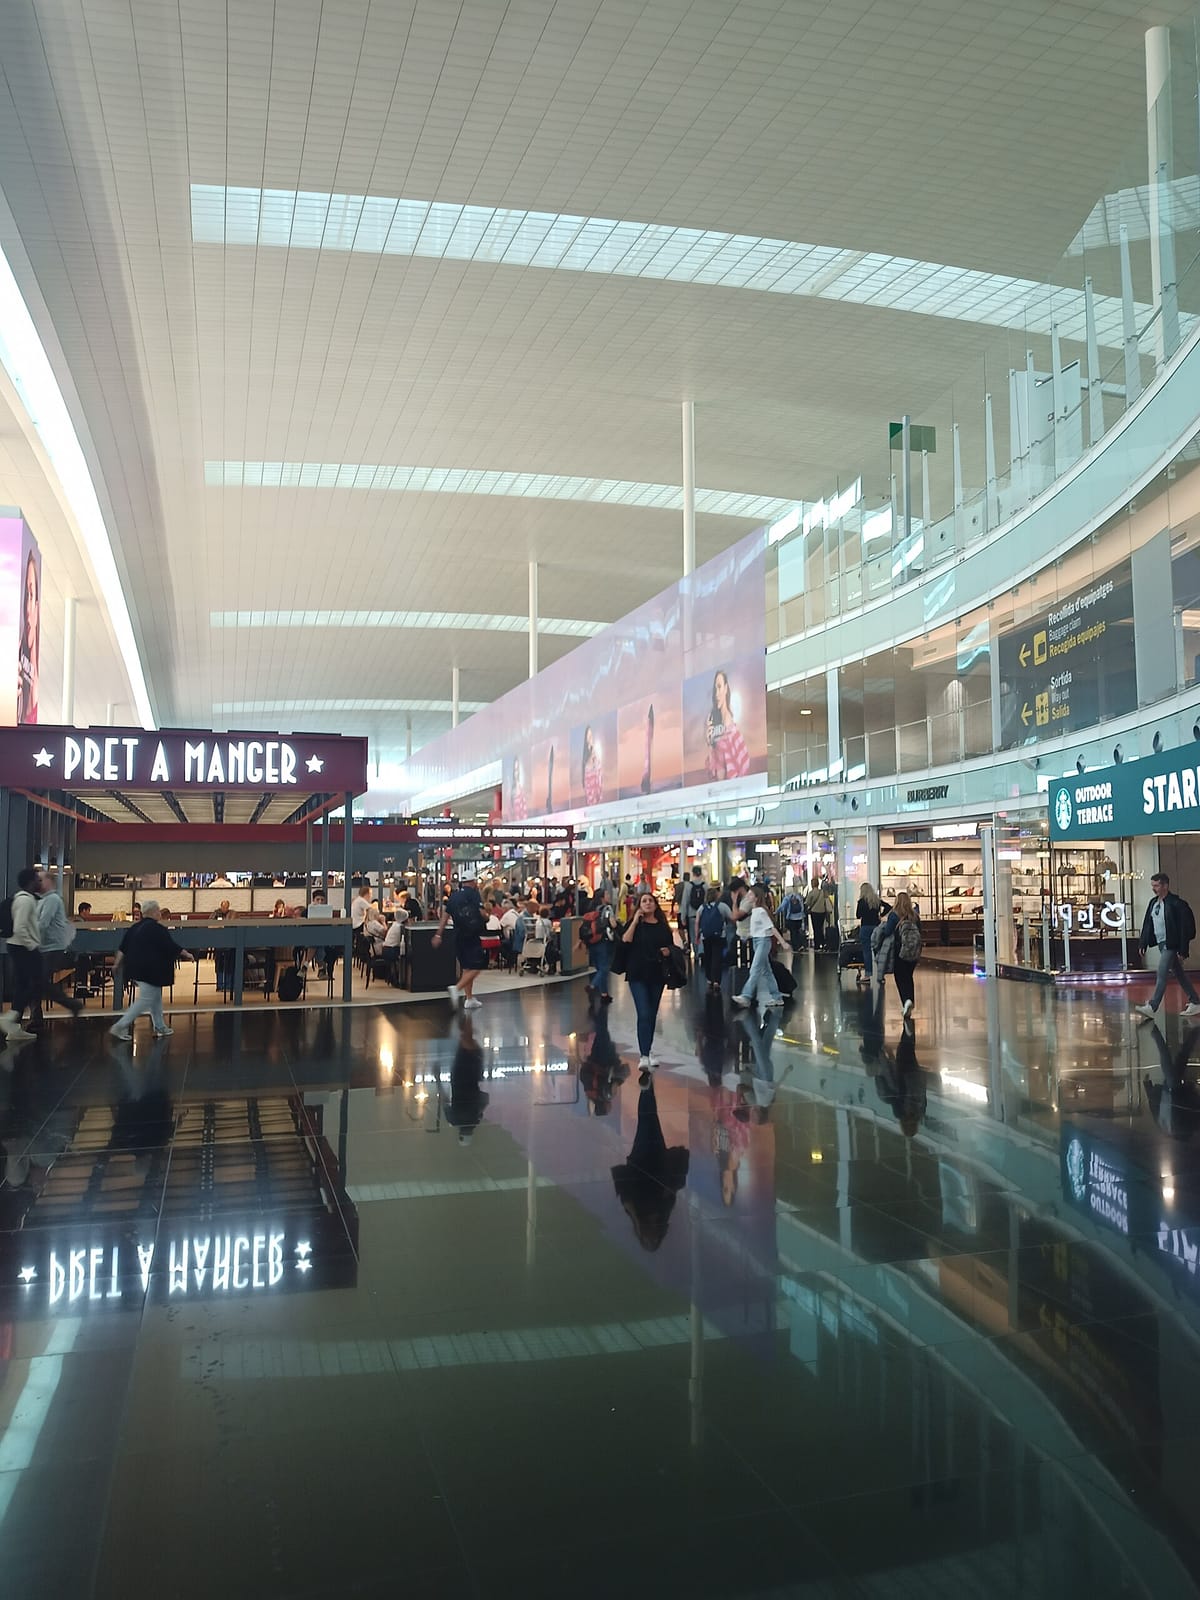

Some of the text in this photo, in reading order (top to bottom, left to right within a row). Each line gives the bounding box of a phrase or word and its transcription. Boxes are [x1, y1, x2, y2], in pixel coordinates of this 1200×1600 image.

[1048, 580, 1114, 627] Recollida d'equipatges
[1049, 616, 1082, 642] Baggage claim
[1050, 621, 1106, 657] Recogida equipajes
[1051, 670, 1072, 689] Sortida
[1051, 688, 1070, 704] Way out
[1052, 704, 1070, 720] Salida
[64, 736, 298, 784] PRET A MANGER
[907, 785, 949, 803] BURBERRY
[1075, 782, 1112, 803] OUTDOOR
[1142, 765, 1200, 815] STAR
[1077, 804, 1113, 825] TERRACE
